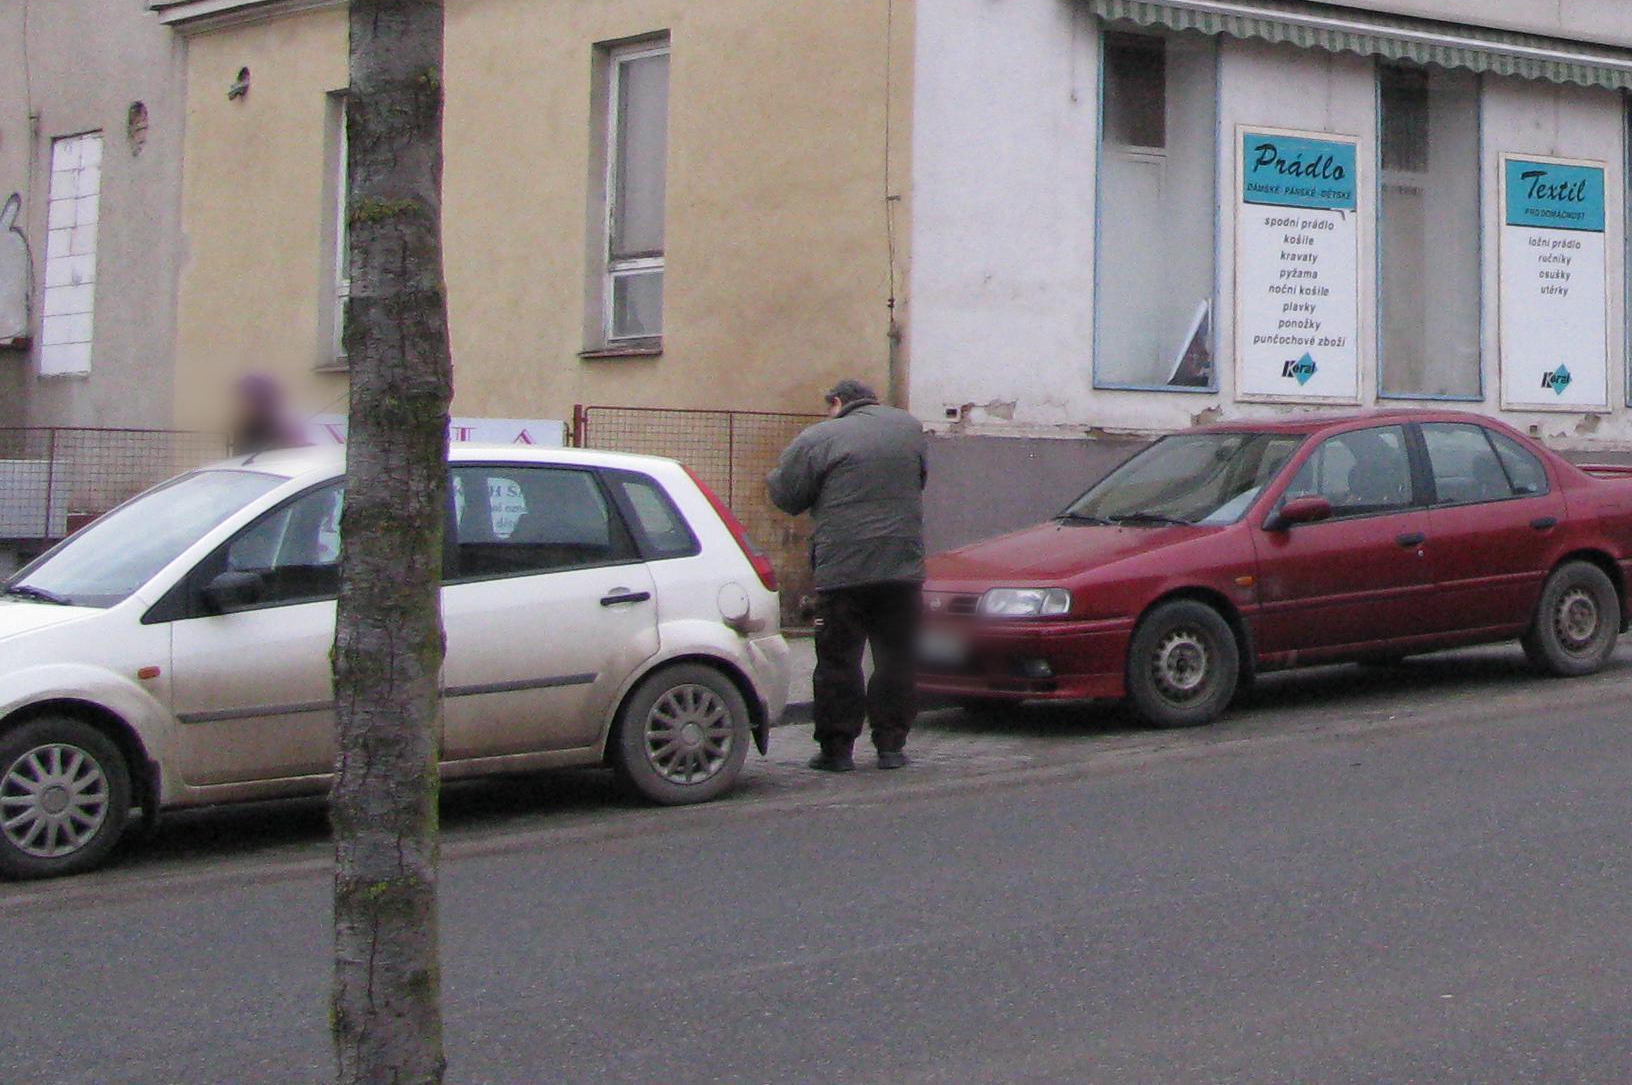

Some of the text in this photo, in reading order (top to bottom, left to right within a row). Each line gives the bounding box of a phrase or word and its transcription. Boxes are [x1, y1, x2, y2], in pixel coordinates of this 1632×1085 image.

[1253, 143, 1346, 181] Prádlo
[1521, 170, 1586, 202] Textil
[1264, 217, 1335, 231] spodní prádlo
[1283, 233, 1315, 245] košile
[1551, 238, 1582, 250] prádlo
[1280, 250, 1319, 264] kravaty
[1280, 268, 1318, 280] pyžama
[1539, 270, 1571, 282] osušky
[1299, 285, 1330, 297] košile
[1283, 302, 1317, 314] plavky
[1278, 319, 1321, 332] ponožky
[1253, 334, 1316, 346] punčochové
